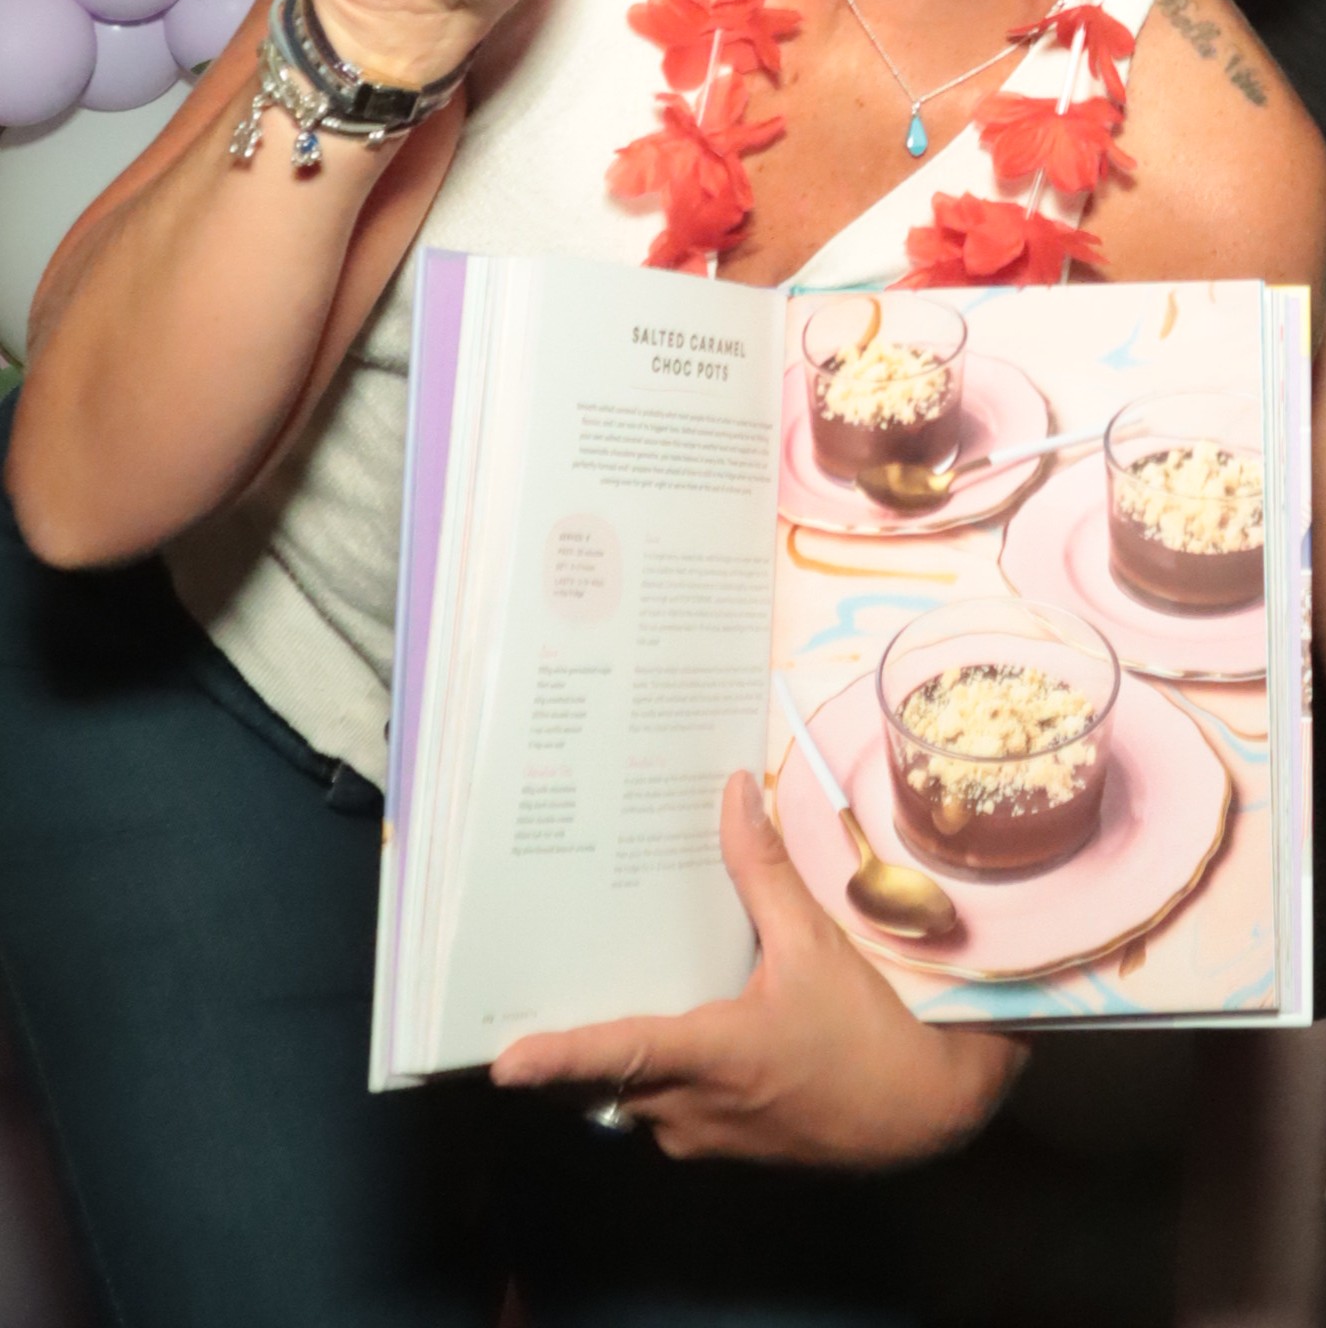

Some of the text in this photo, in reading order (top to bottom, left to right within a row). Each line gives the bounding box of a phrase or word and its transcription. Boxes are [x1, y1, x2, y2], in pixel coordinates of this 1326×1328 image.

[632, 327, 745, 358] SALTED CARAMEL
[652, 357, 729, 381] CHOC POTS
